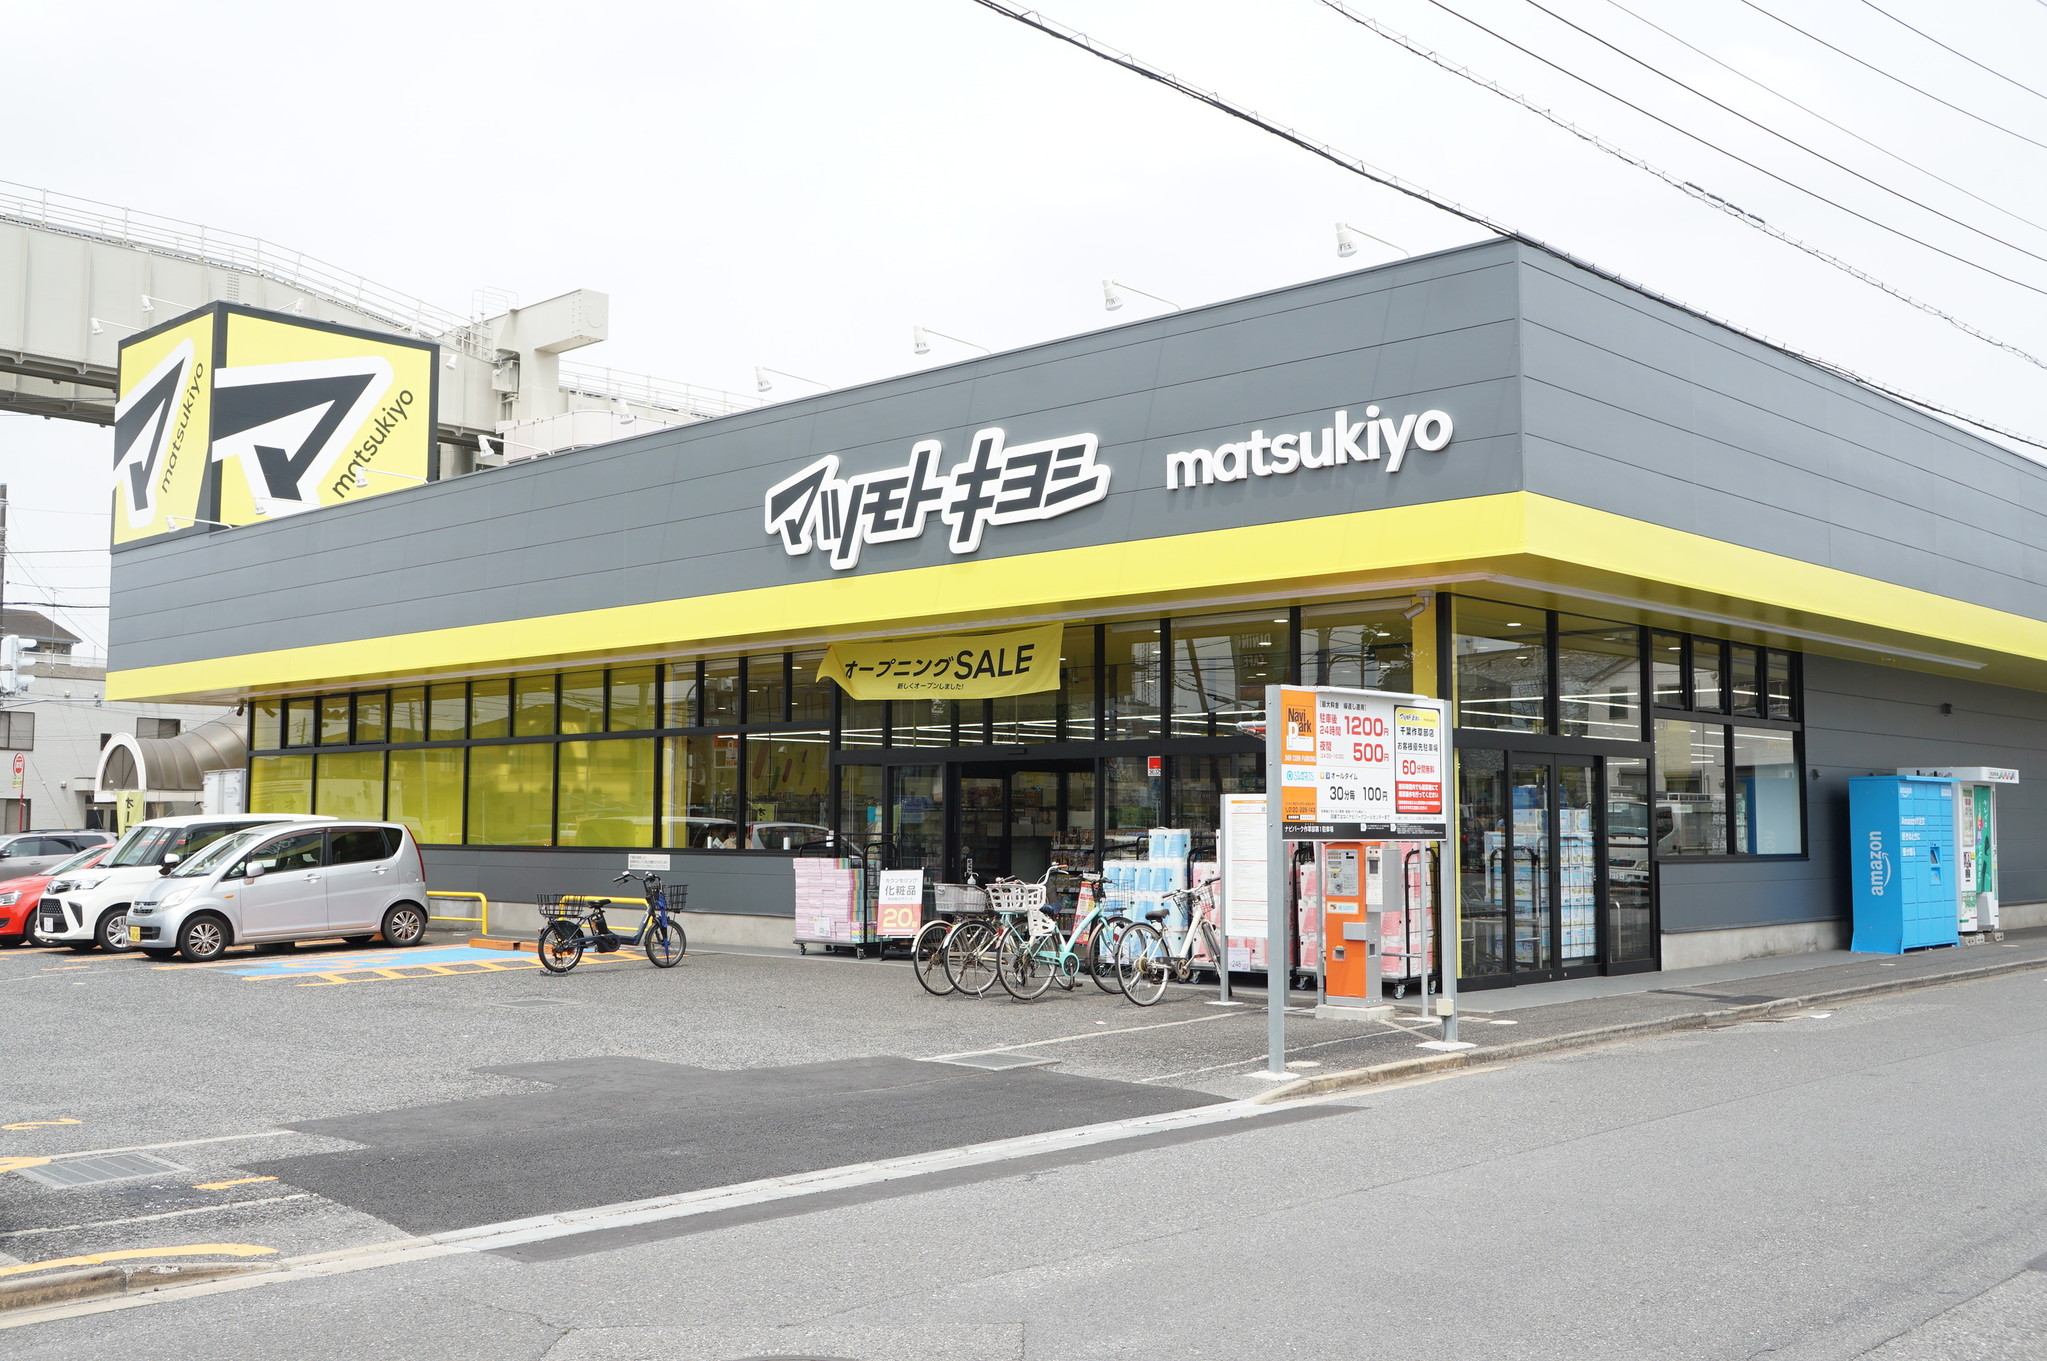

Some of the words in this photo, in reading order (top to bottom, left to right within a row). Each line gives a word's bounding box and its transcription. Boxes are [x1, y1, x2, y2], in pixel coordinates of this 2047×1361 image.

[161, 361, 205, 493] matsukiyo
[331, 389, 414, 499] matsukiyo
[1166, 404, 1454, 490] matsukiyo
[764, 427, 1112, 570] マツモトキヨシ
[1288, 708, 1306, 722] Navi
[1288, 720, 1312, 747] Park
[1319, 725, 1342, 736] 24時間
[1344, 716, 1390, 737] 1200円
[1319, 740, 1332, 751] 夜間
[1353, 742, 1390, 762] 500円
[1329, 786, 1356, 800] 30分毎
[1362, 786, 1388, 801] 100円
[1869, 831, 1884, 896] amazon
[884, 885, 917, 896] 化粧品
